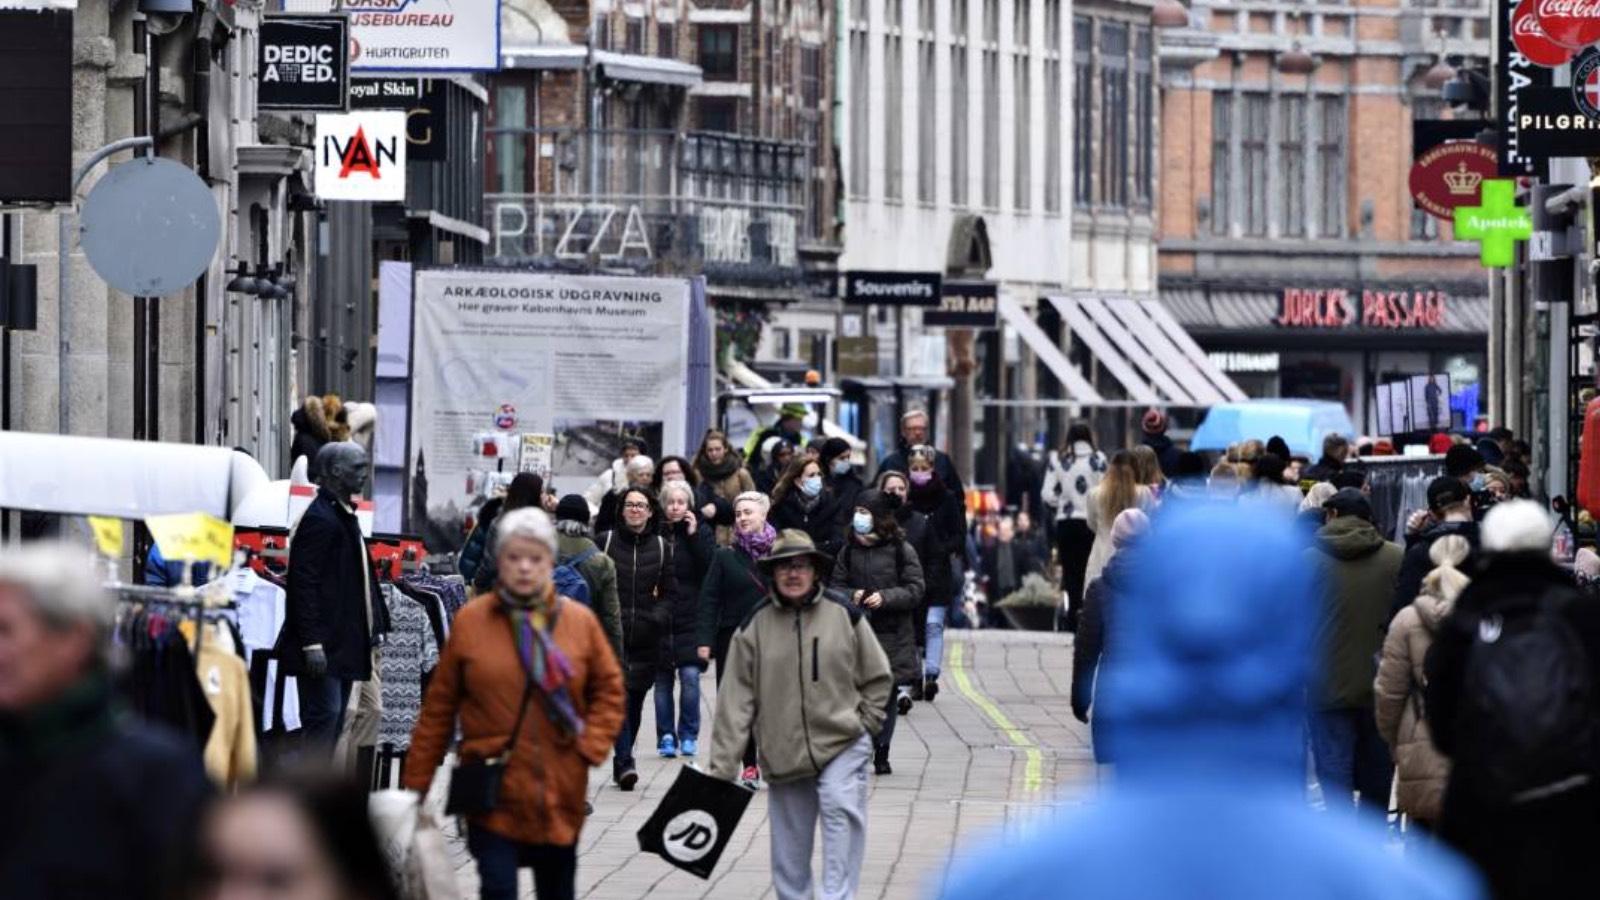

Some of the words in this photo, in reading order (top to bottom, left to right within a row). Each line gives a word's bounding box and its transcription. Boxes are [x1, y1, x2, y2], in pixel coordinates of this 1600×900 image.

[264, 44, 333, 64] DEDIC
[350, 82, 379, 98] oyal
[383, 82, 415, 96] Skin
[1520, 115, 1600, 129] PILGRI
[323, 124, 397, 179] IVAN
[495, 202, 652, 259] PIZZA
[1467, 216, 1529, 231] Apotek
[444, 286, 554, 300] ARKÆOLOGISK
[559, 289, 662, 303] UDGRAVNING
[854, 279, 932, 298] Souvenirs
[458, 302, 479, 312] Her
[482, 303, 519, 315] graver
[522, 303, 593, 316] Københavns
[596, 306, 647, 317] Museum
[1363, 289, 1446, 328] PASSAGE
[668, 822, 711, 850] JD
